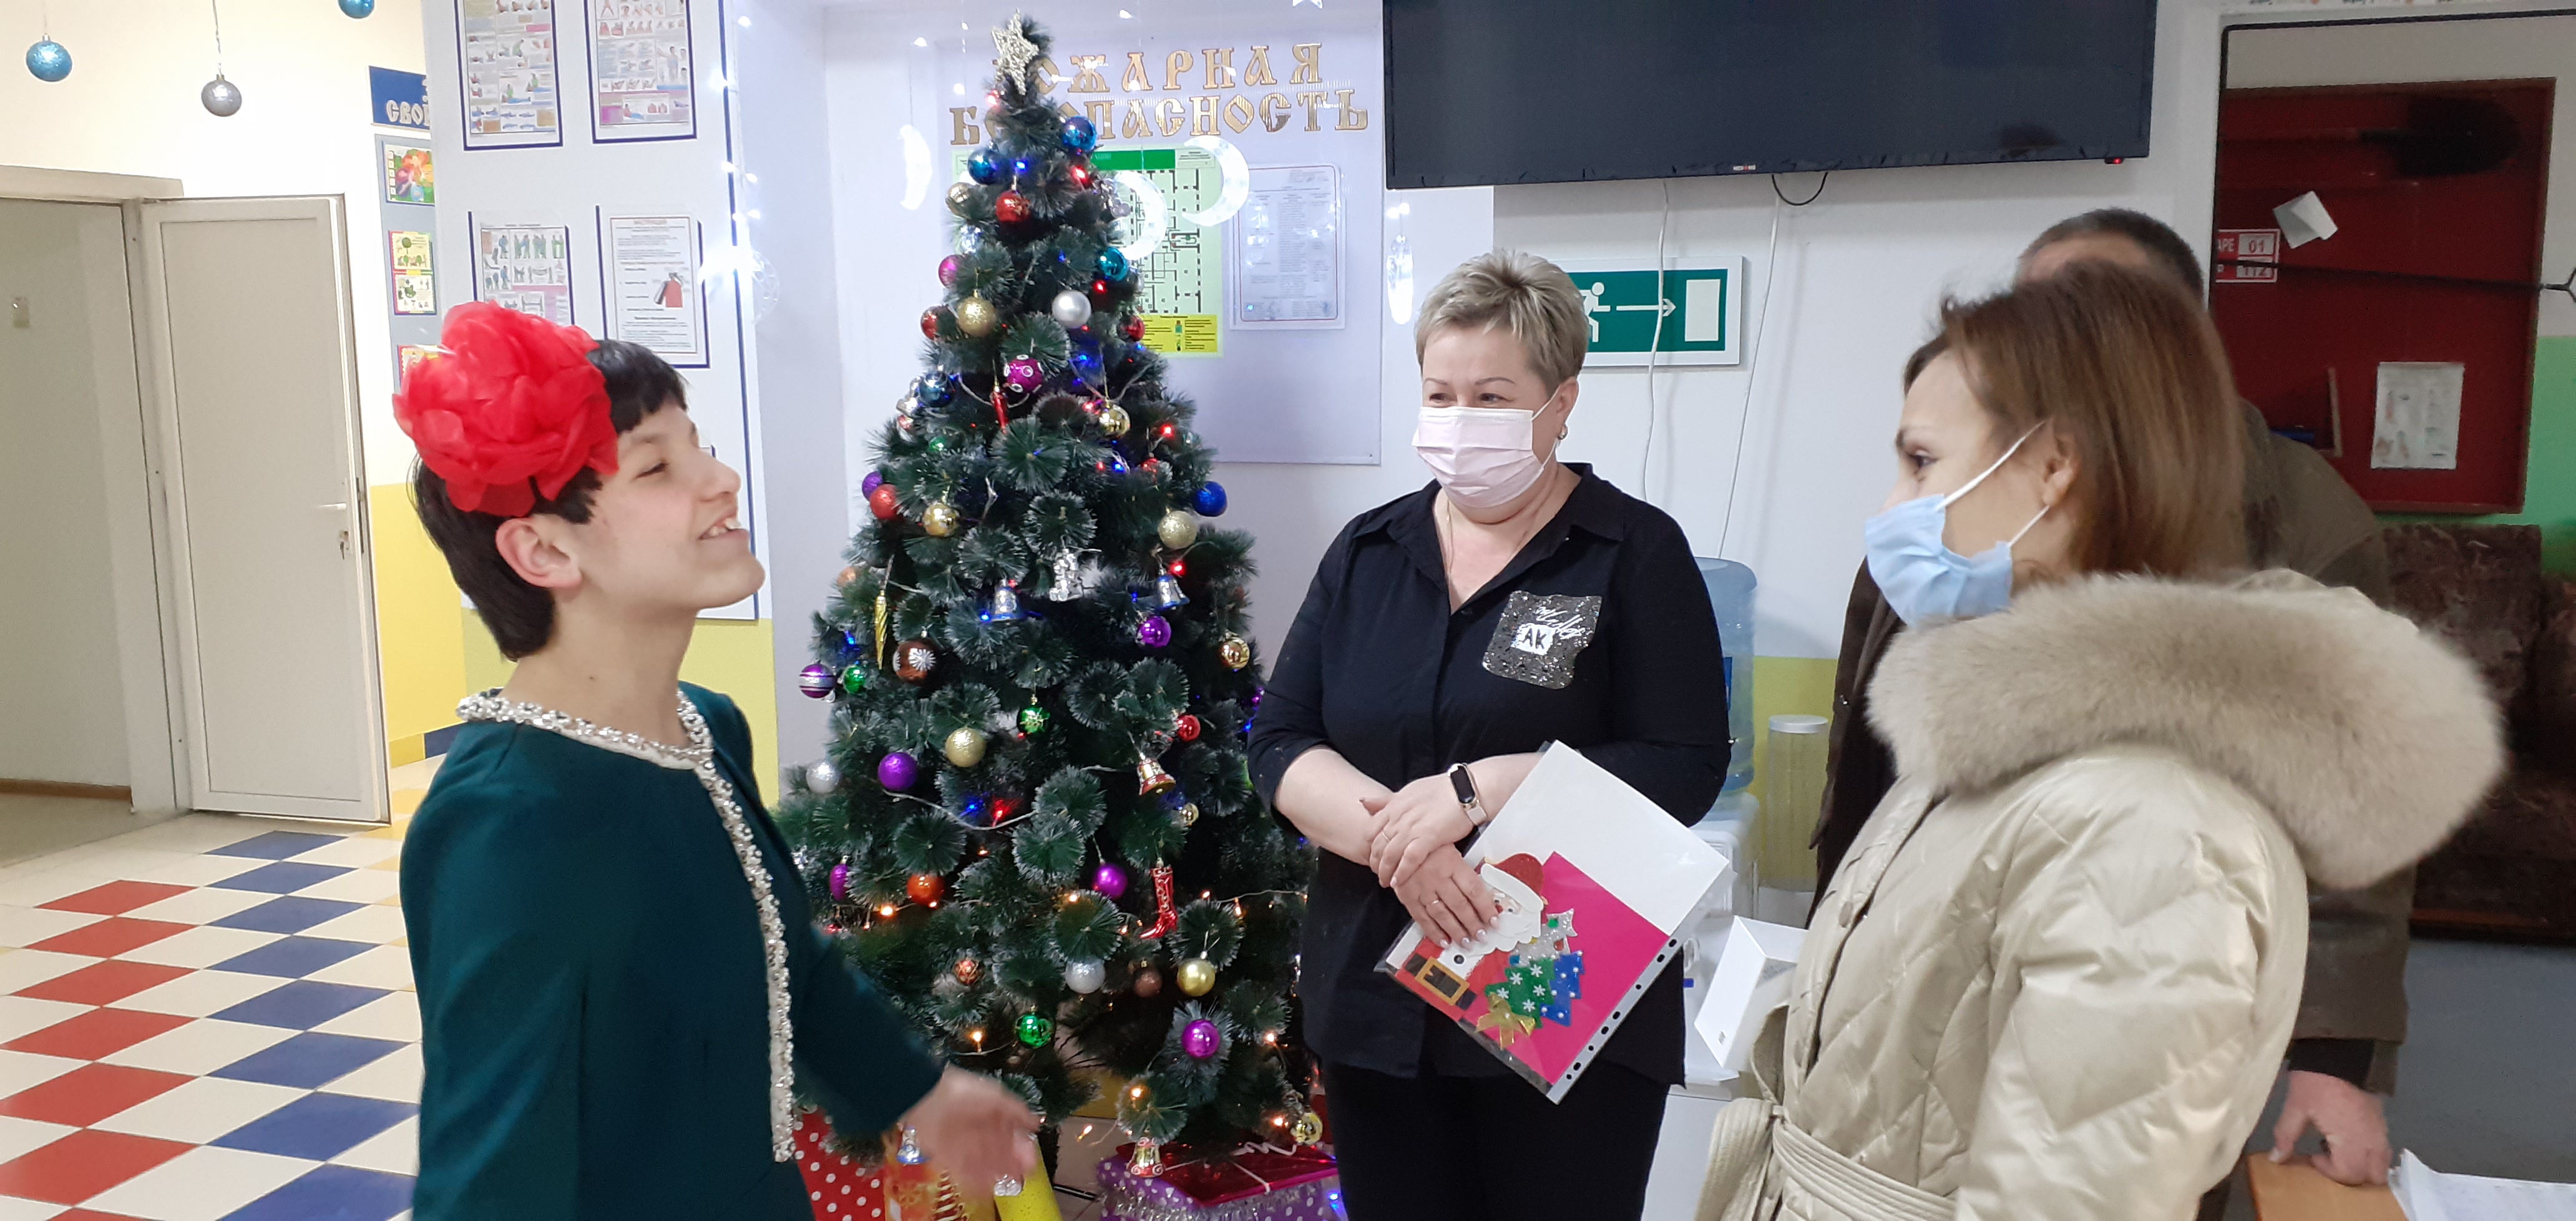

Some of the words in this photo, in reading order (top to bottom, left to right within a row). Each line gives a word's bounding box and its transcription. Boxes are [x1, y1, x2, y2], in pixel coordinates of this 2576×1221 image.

[992, 43, 1322, 95] ОЖАРНАЯ
[950, 89, 1368, 145] БПАСНОСТЬ
[2249, 240, 2265, 253] 01
